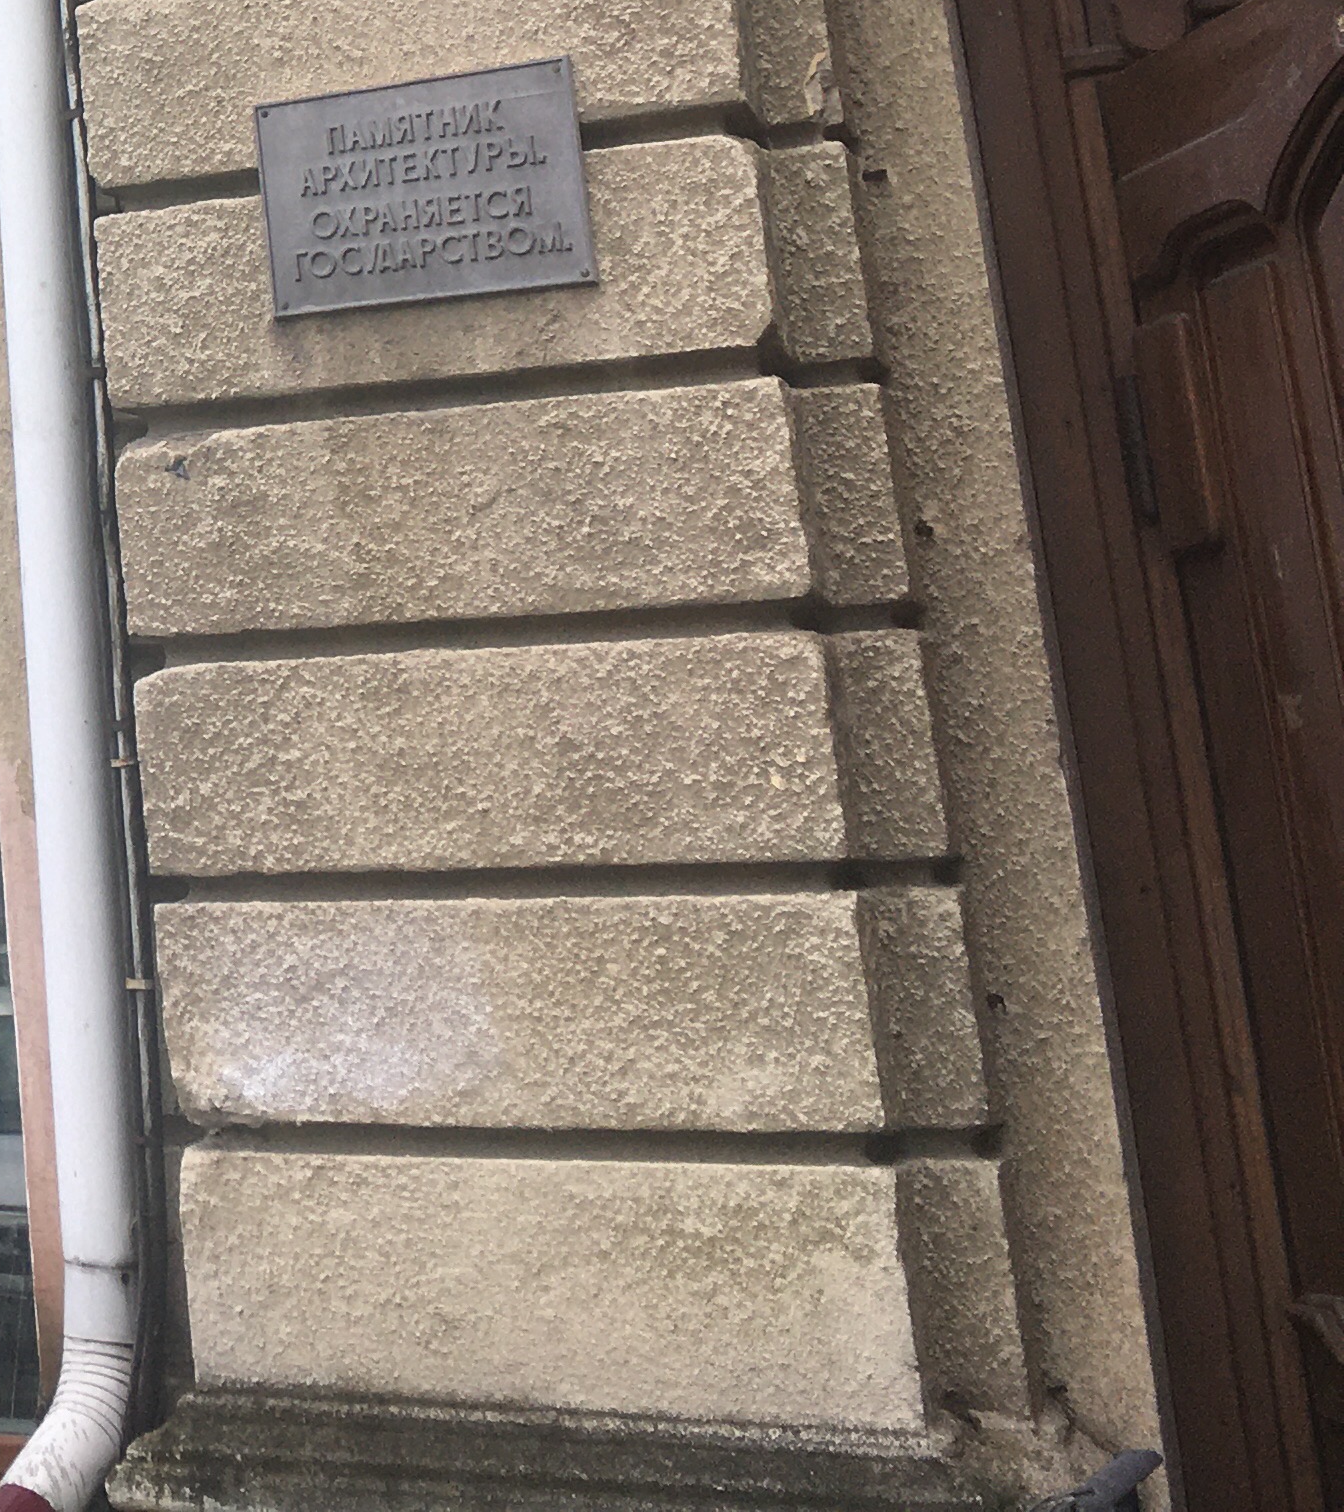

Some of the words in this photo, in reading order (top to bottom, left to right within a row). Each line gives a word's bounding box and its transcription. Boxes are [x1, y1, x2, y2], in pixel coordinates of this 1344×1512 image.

[326, 99, 505, 155] ПАМЯТНИК
[300, 134, 548, 198] АРХИТЕКТУРЫ.
[312, 185, 533, 240] ОХРАНЯЕТСЯ
[294, 221, 573, 283] ГОСУДАРСТВОМ.
